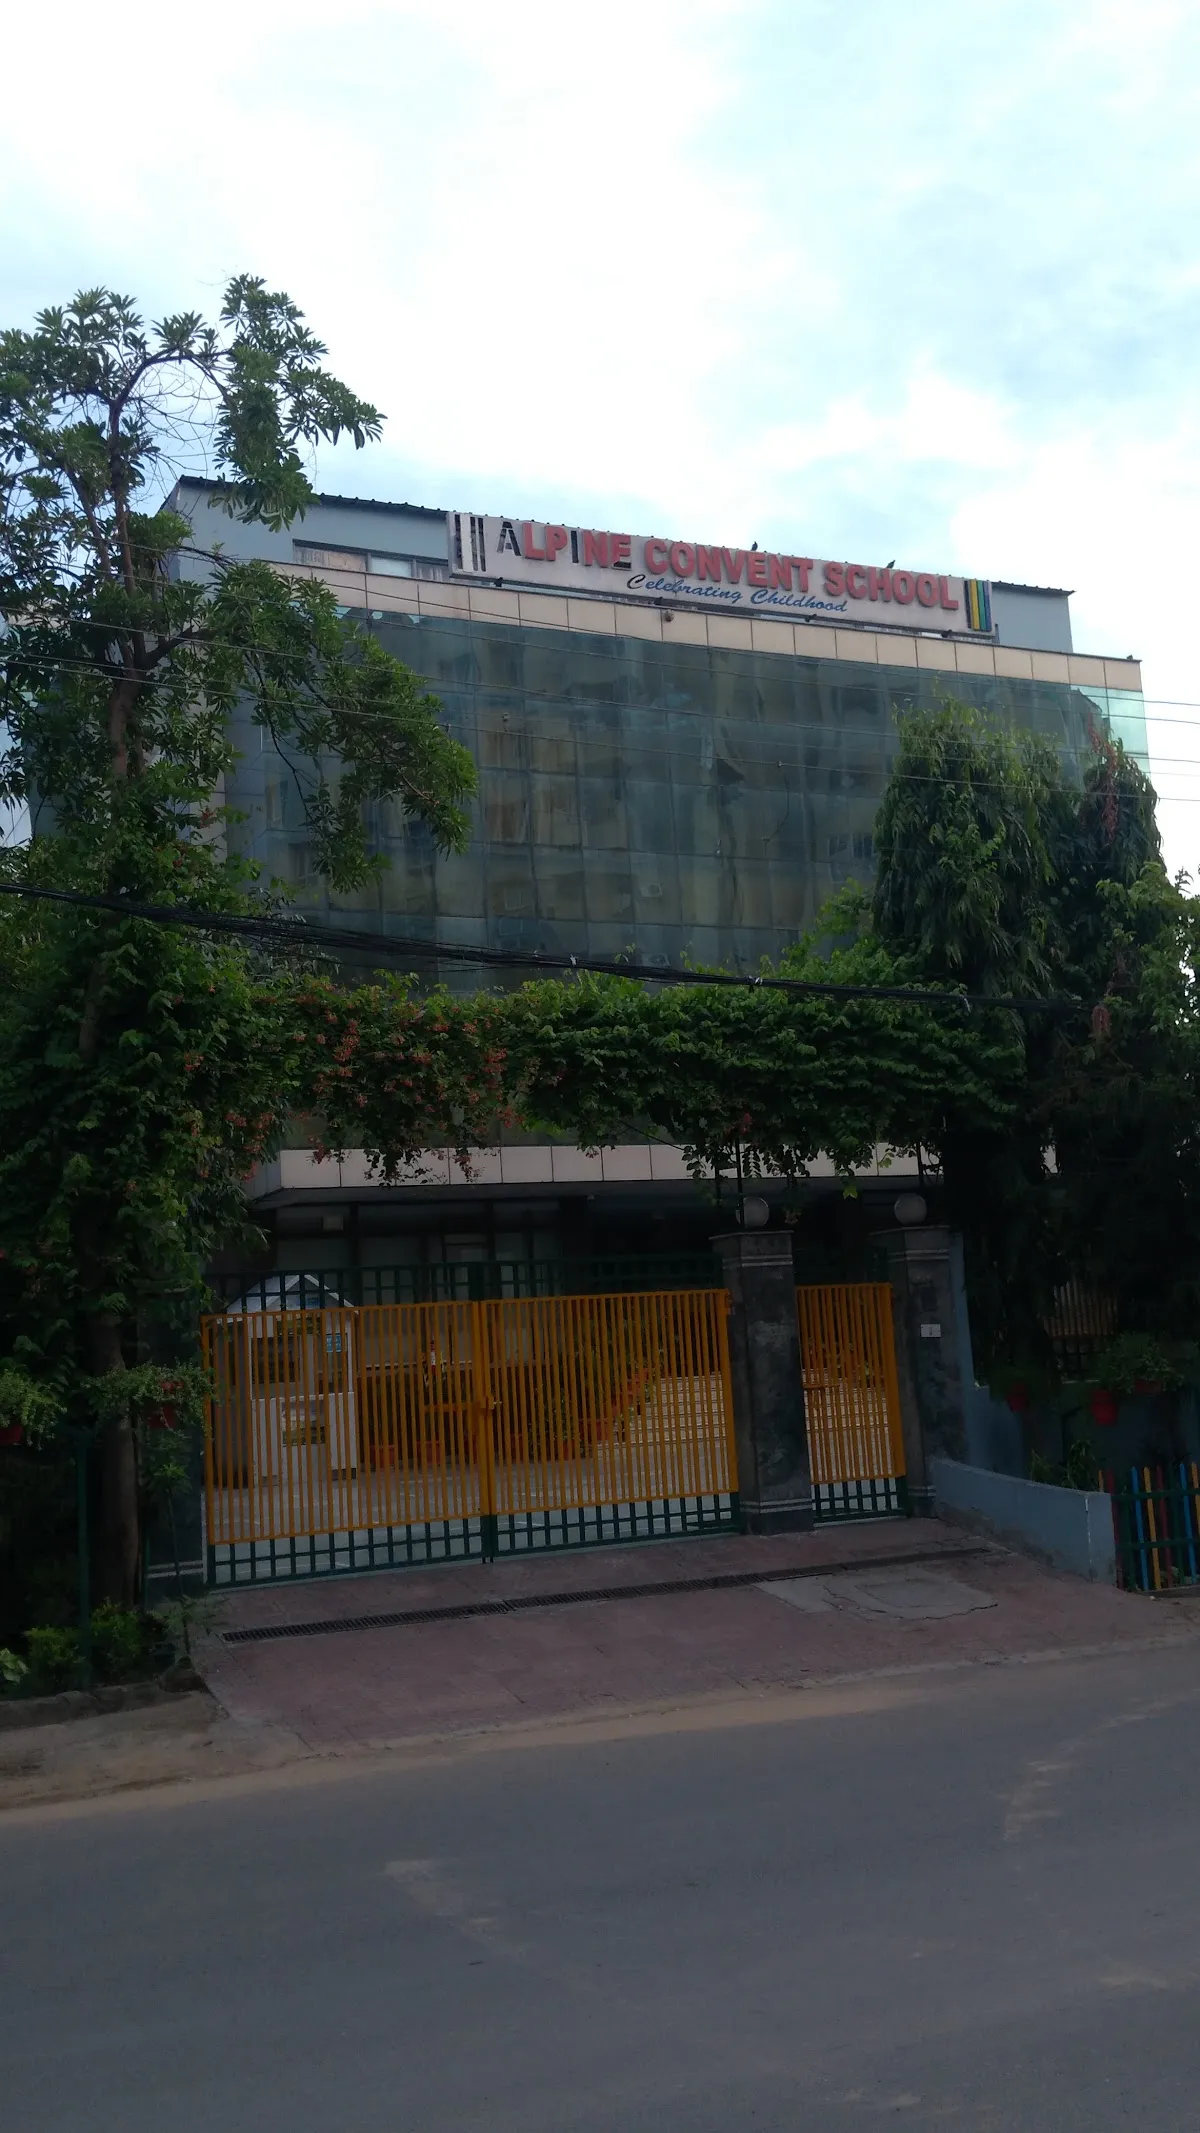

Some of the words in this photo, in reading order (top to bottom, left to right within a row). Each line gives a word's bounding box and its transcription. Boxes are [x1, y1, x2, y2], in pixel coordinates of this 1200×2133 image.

[497, 521, 632, 570] ALPINE
[645, 538, 813, 592] CONVENT
[824, 562, 959, 610] SCHOOL
[627, 573, 743, 604] Celebrating
[750, 588, 848, 613] Childhood
